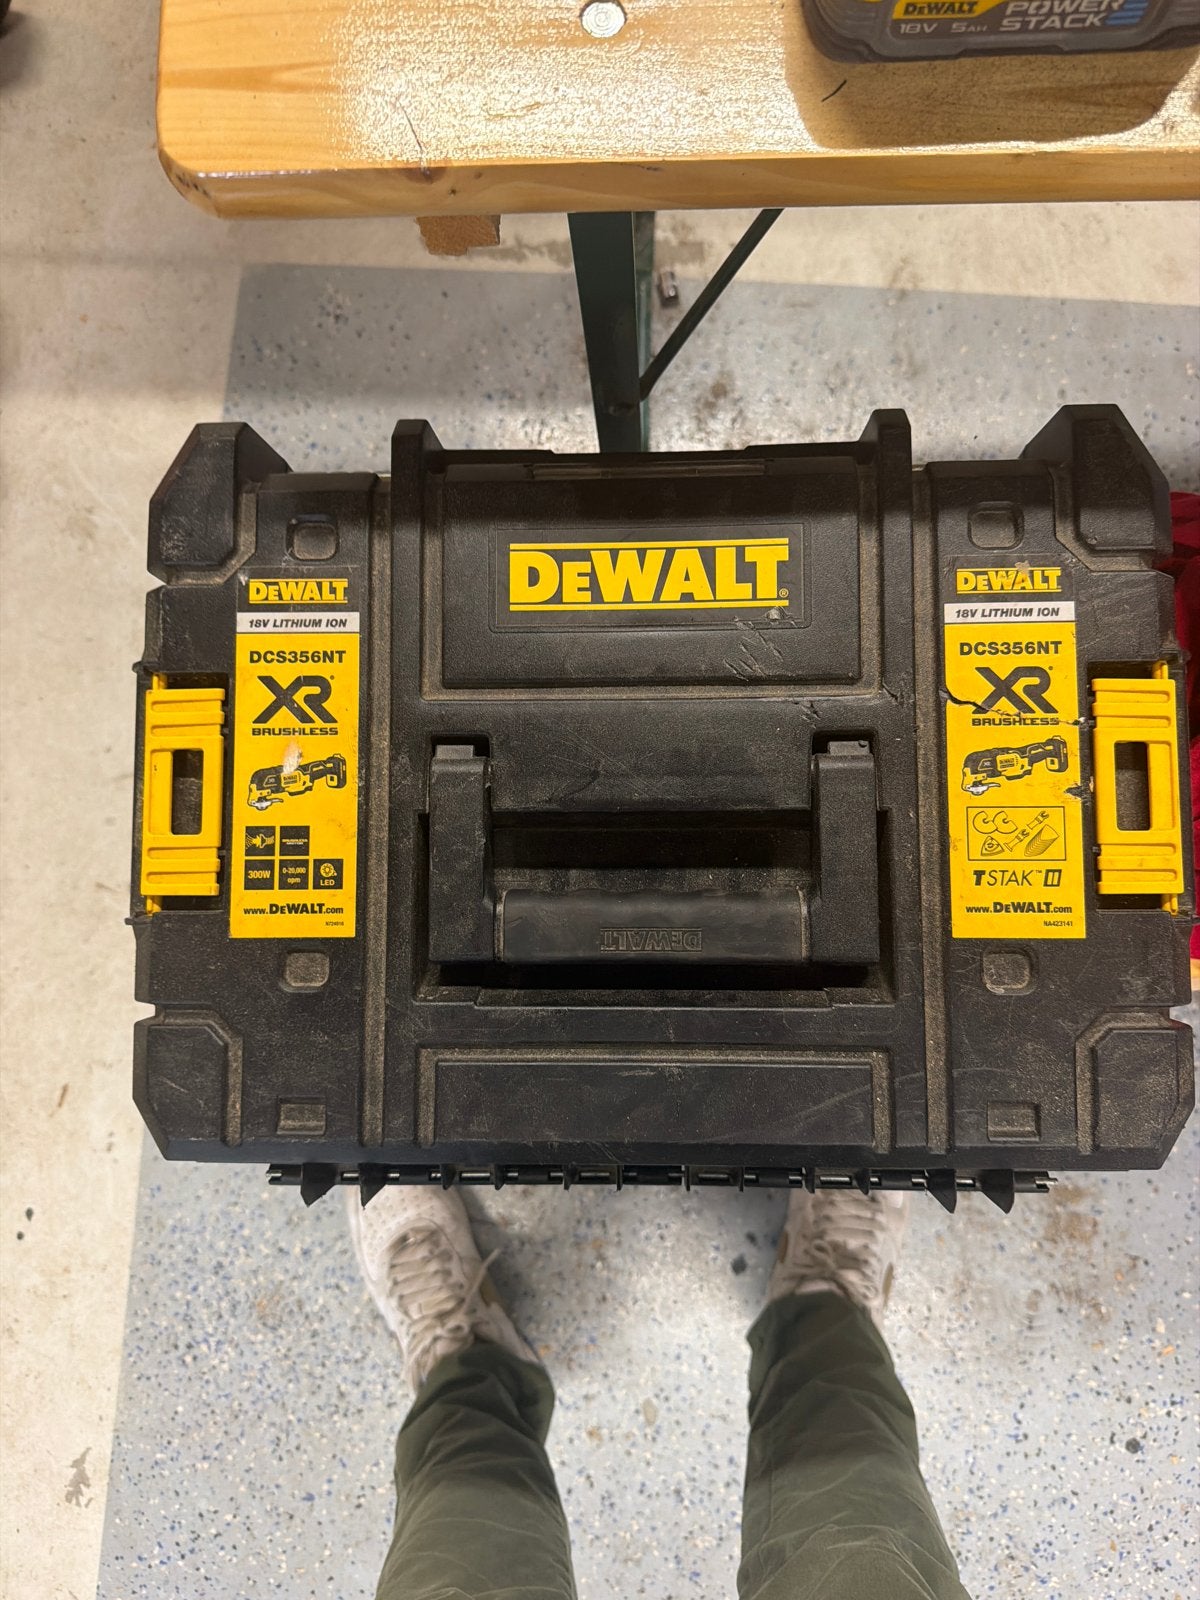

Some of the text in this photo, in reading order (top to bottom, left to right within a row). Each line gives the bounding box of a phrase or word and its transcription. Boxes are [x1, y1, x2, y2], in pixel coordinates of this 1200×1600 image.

[903, 2, 977, 15] DEWALT
[900, 23, 938, 34] 18V
[999, 13, 1106, 32] STACK
[510, 545, 789, 603] DEWALT
[957, 570, 1062, 591] DEWALT
[249, 581, 348, 601] DEWALT
[955, 607, 1060, 618] 18V LITHIUM ION
[249, 618, 348, 628] 18V LITHIUM ION
[960, 641, 1062, 655] DCS356NT
[250, 650, 346, 664] DCS356NT
[972, 666, 1059, 714] XR
[252, 675, 338, 723] XR
[972, 717, 1060, 726] BRUSHLESS
[252, 727, 339, 736] BRUSHLESS
[248, 870, 271, 878] 300W
[244, 903, 343, 914] www.DEWALT.com
[966, 901, 1073, 914] www.DEWALT.com
